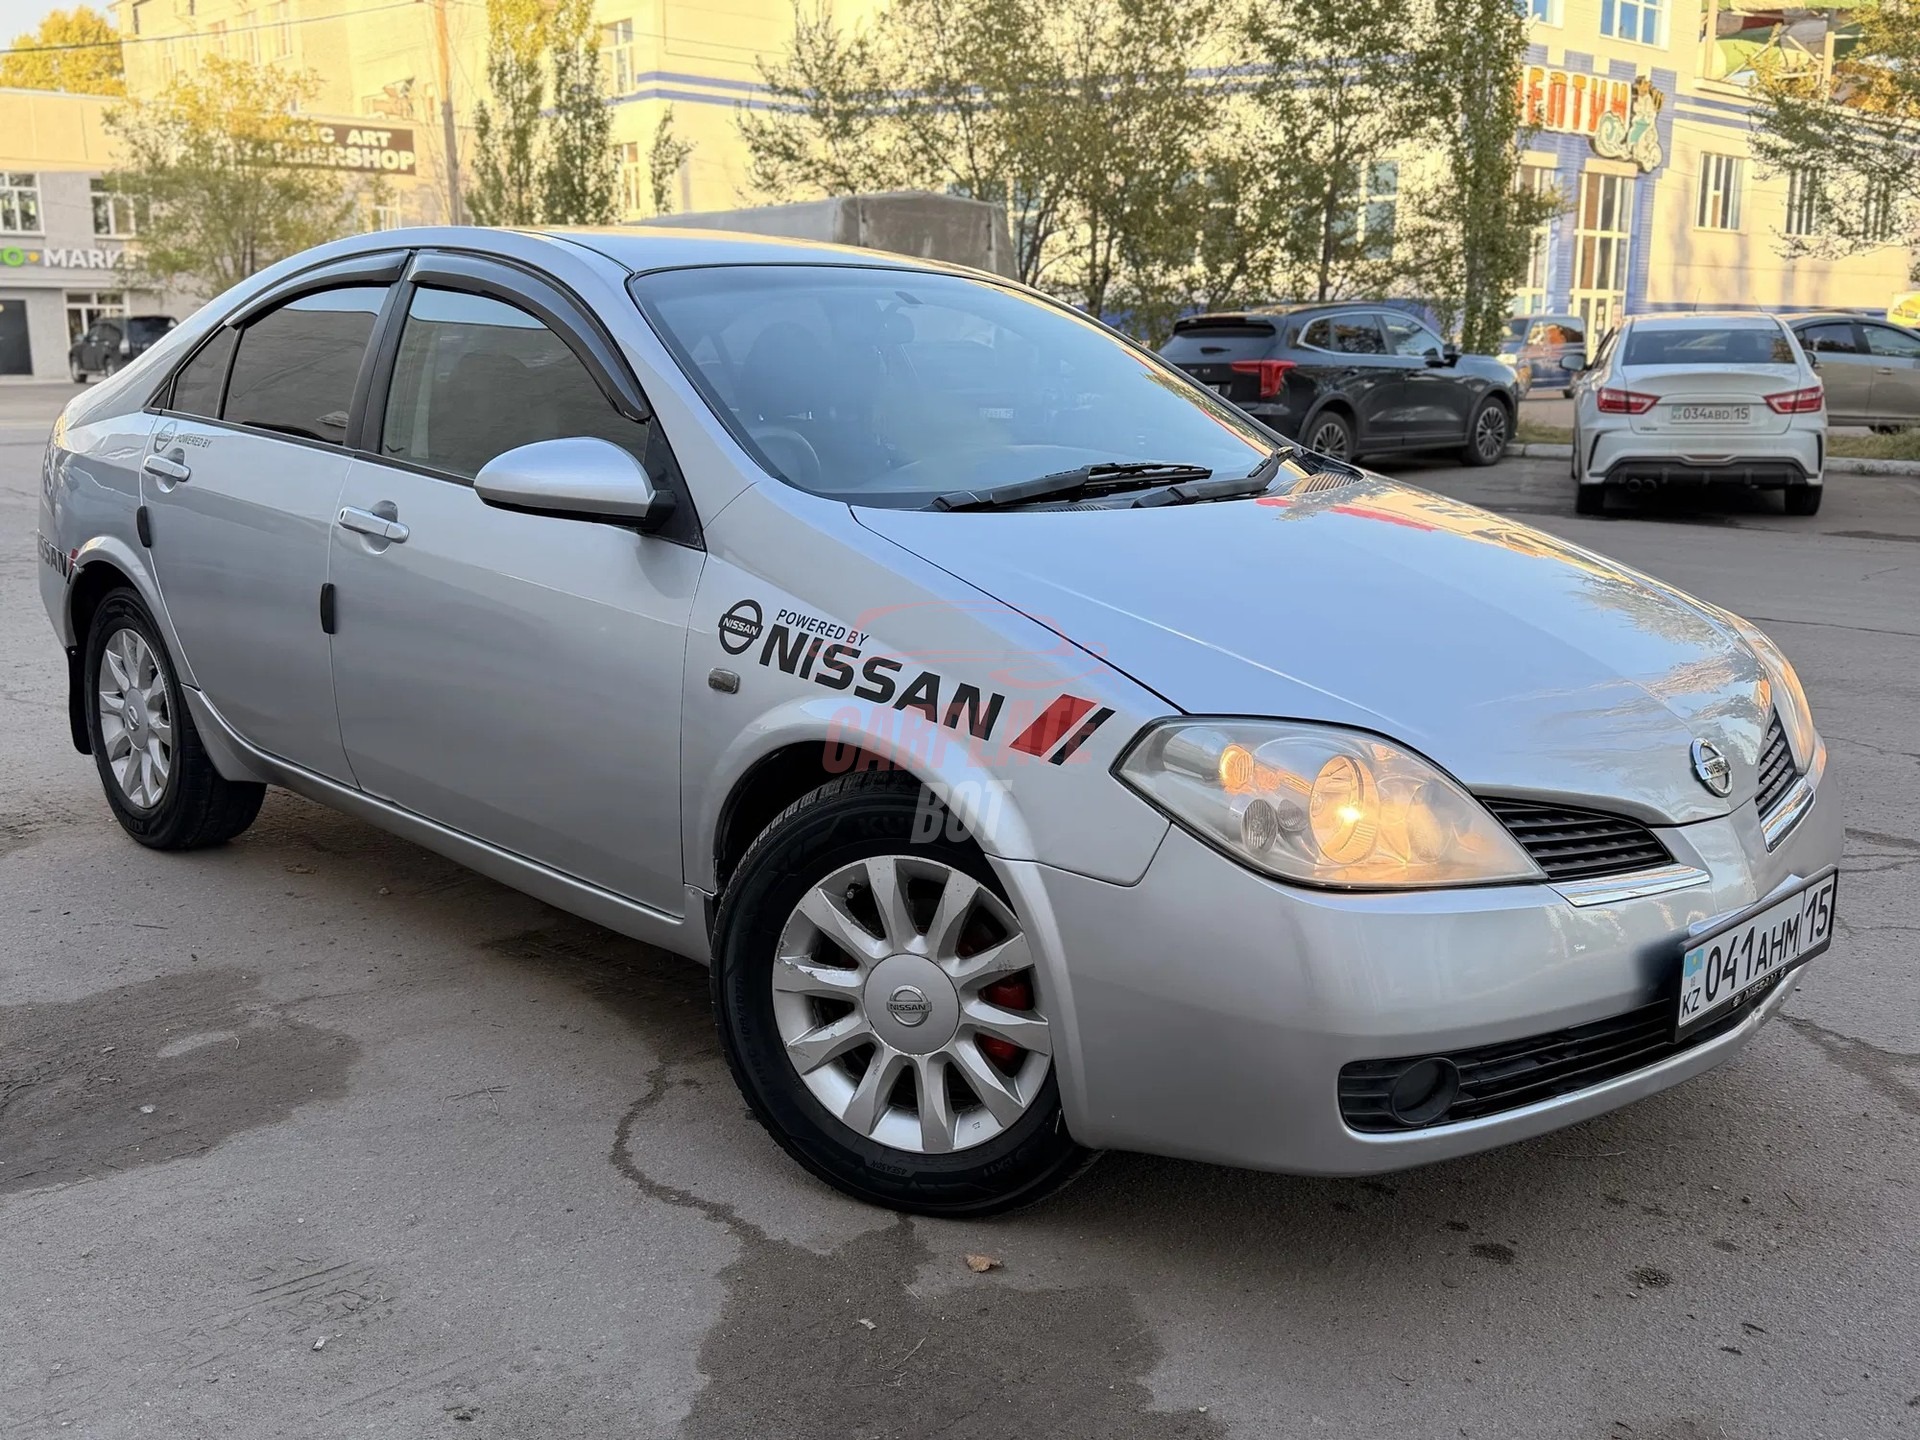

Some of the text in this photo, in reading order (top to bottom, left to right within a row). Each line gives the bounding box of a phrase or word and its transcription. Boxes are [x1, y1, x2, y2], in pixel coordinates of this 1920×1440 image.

[346, 129, 392, 147] ART
[1683, 408, 1730, 420] 034ABD
[1734, 408, 1748, 420] 15
[722, 617, 759, 636] NISSAN
[776, 608, 870, 647] POWERED BY
[759, 623, 1005, 742] NISSAN
[1681, 884, 1832, 1018] KZ 041AHM 15
